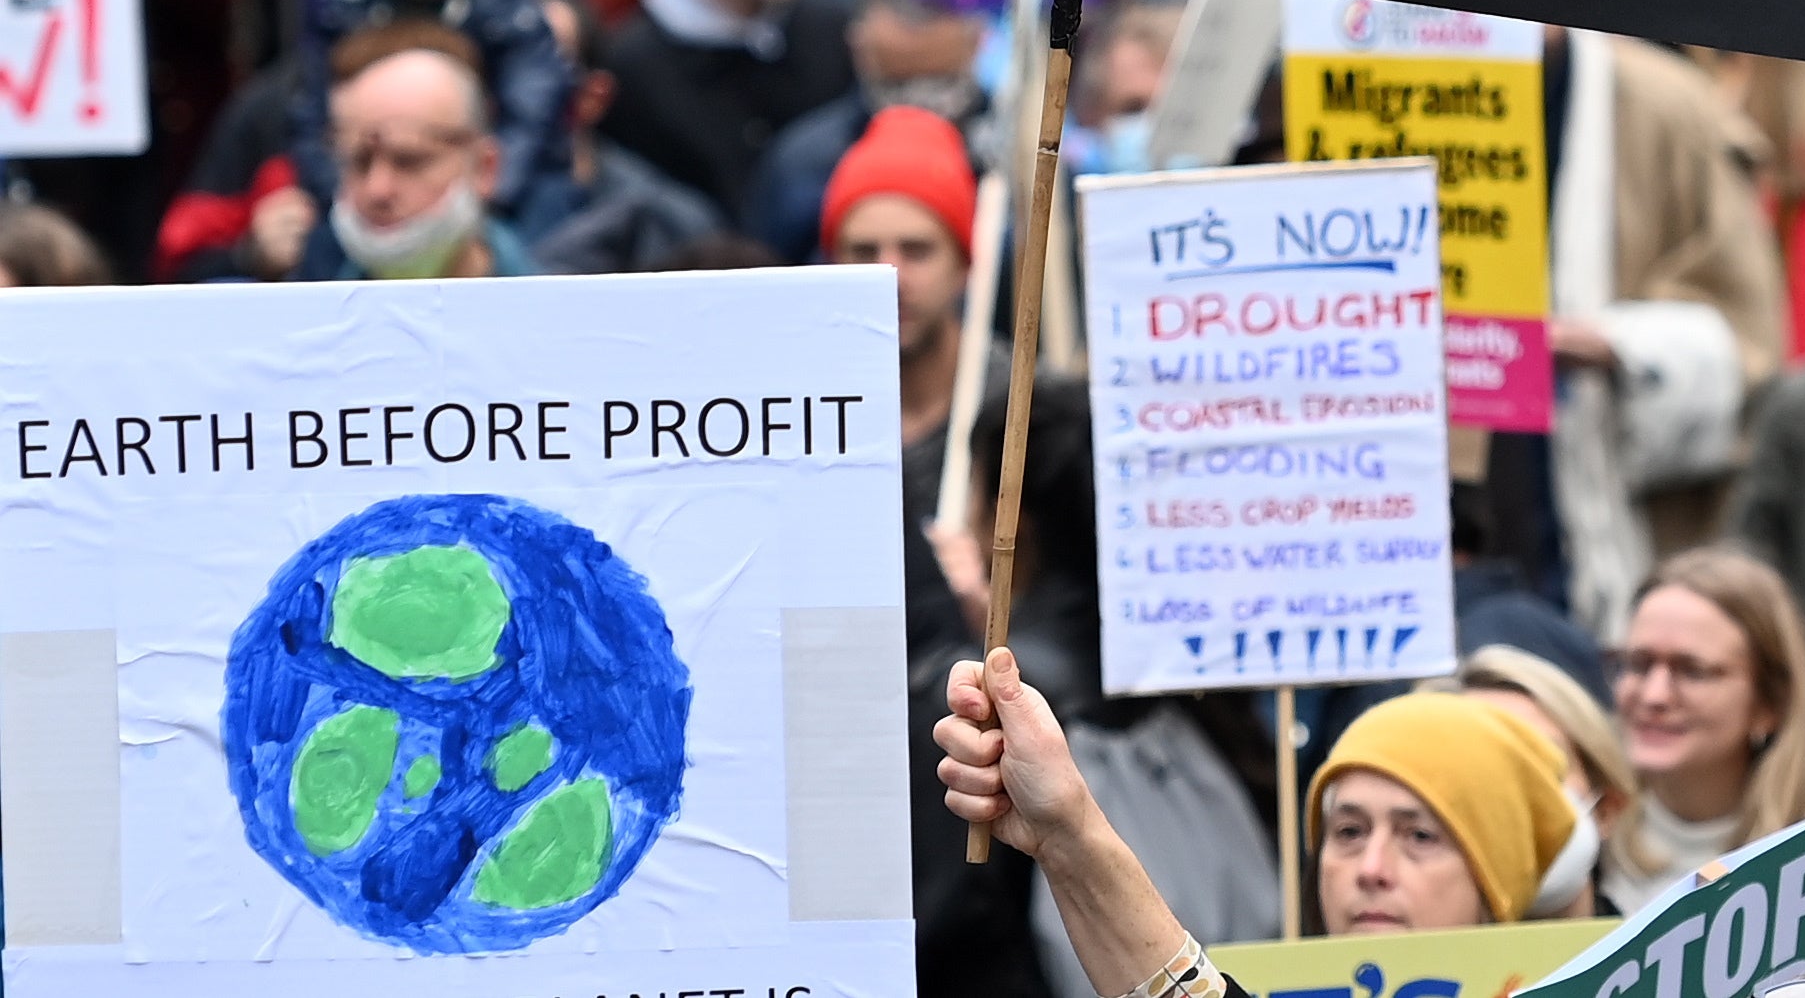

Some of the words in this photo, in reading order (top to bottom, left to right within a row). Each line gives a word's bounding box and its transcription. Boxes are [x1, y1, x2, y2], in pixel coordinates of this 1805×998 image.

[1320, 68, 1507, 126] Migrants
[1149, 209, 1236, 266] IT'S
[1275, 205, 1430, 258] NOW!
[1148, 291, 1435, 340] DROUGHT
[1150, 340, 1402, 384] WILDFIRES
[1139, 396, 1292, 432] COASTAL
[1304, 391, 1434, 420] EROSION
[18, 413, 254, 479] EARTH
[290, 402, 570, 469] BEFORE
[603, 395, 864, 459] PROFIT
[1147, 443, 1387, 480] FLOODING
[1148, 500, 1233, 528] LESS
[1240, 494, 1319, 526] CROP
[1328, 493, 1416, 523] YIELDS
[1147, 543, 1236, 574] LESS
[1243, 541, 1346, 570] WATER
[1139, 600, 1213, 623] LOSS
[1233, 596, 1277, 621] OF
